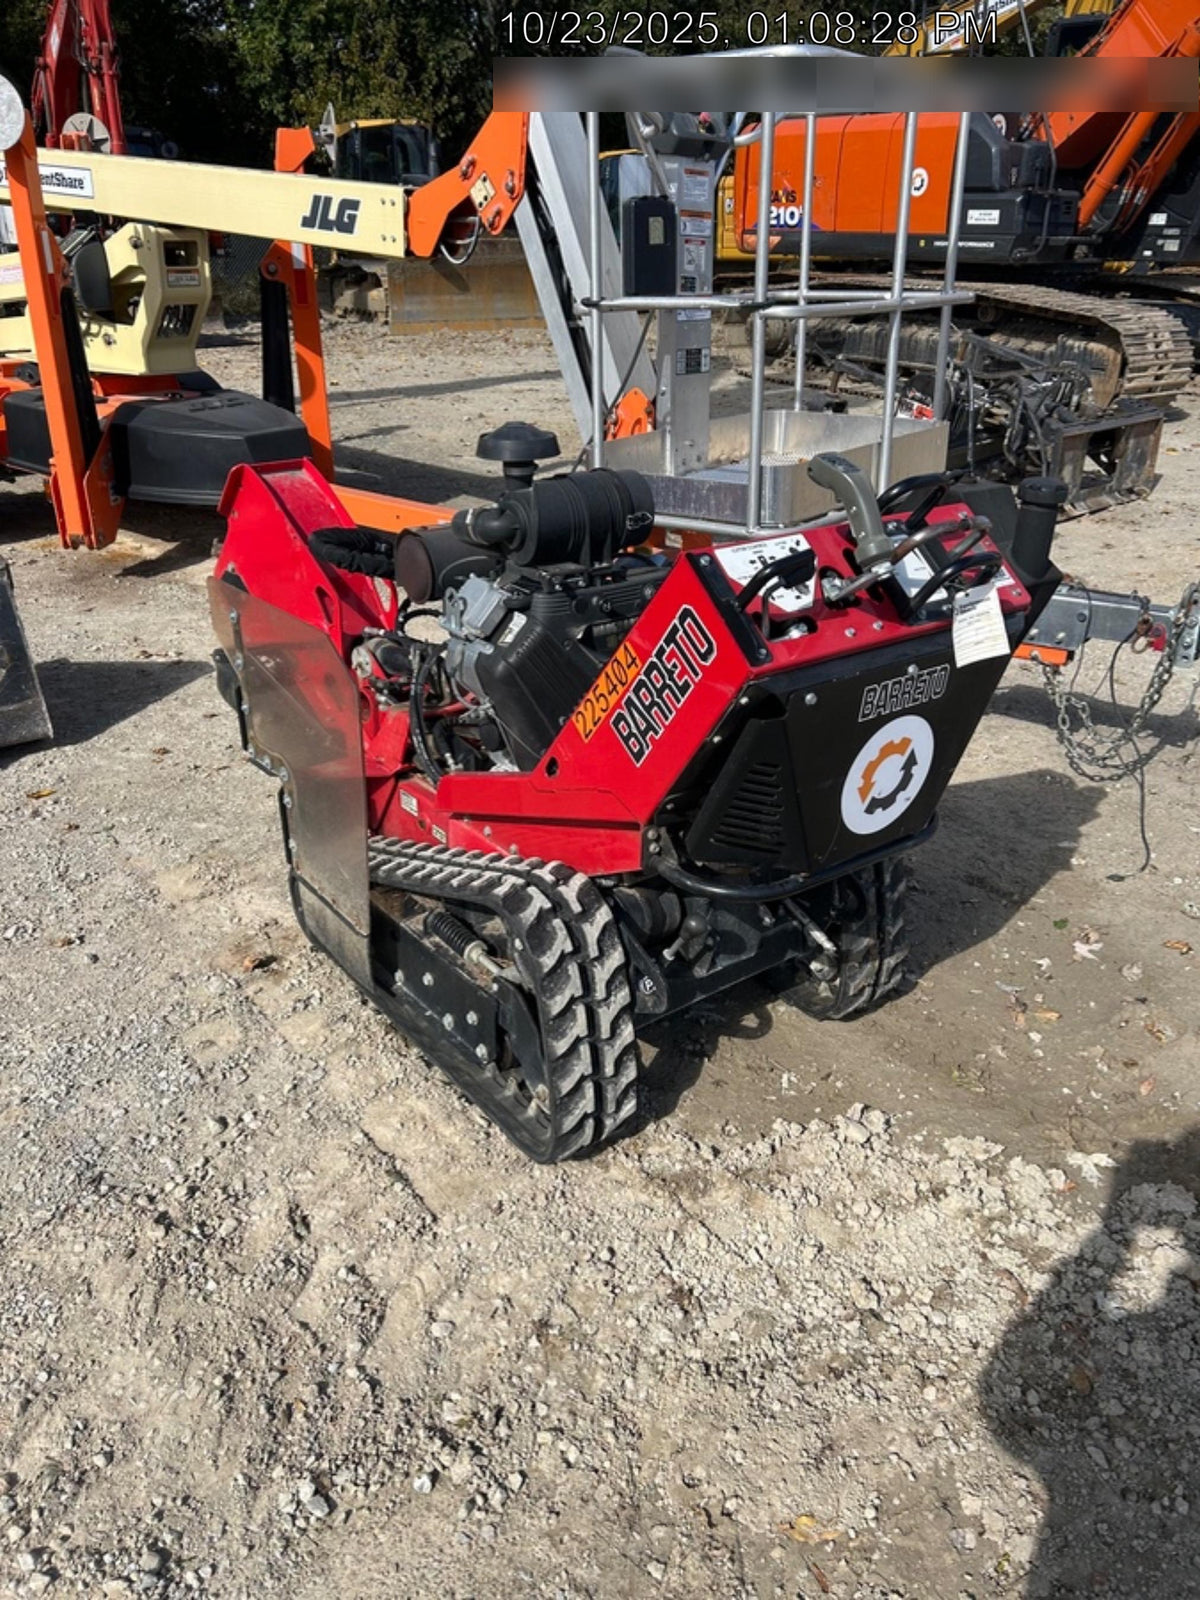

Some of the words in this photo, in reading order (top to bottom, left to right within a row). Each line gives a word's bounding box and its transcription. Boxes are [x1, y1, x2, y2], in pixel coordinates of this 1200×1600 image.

[300, 194, 361, 235] JLG
[574, 643, 640, 740] 225404
[610, 604, 718, 768] BARRETO
[858, 663, 951, 722] BARRETO
